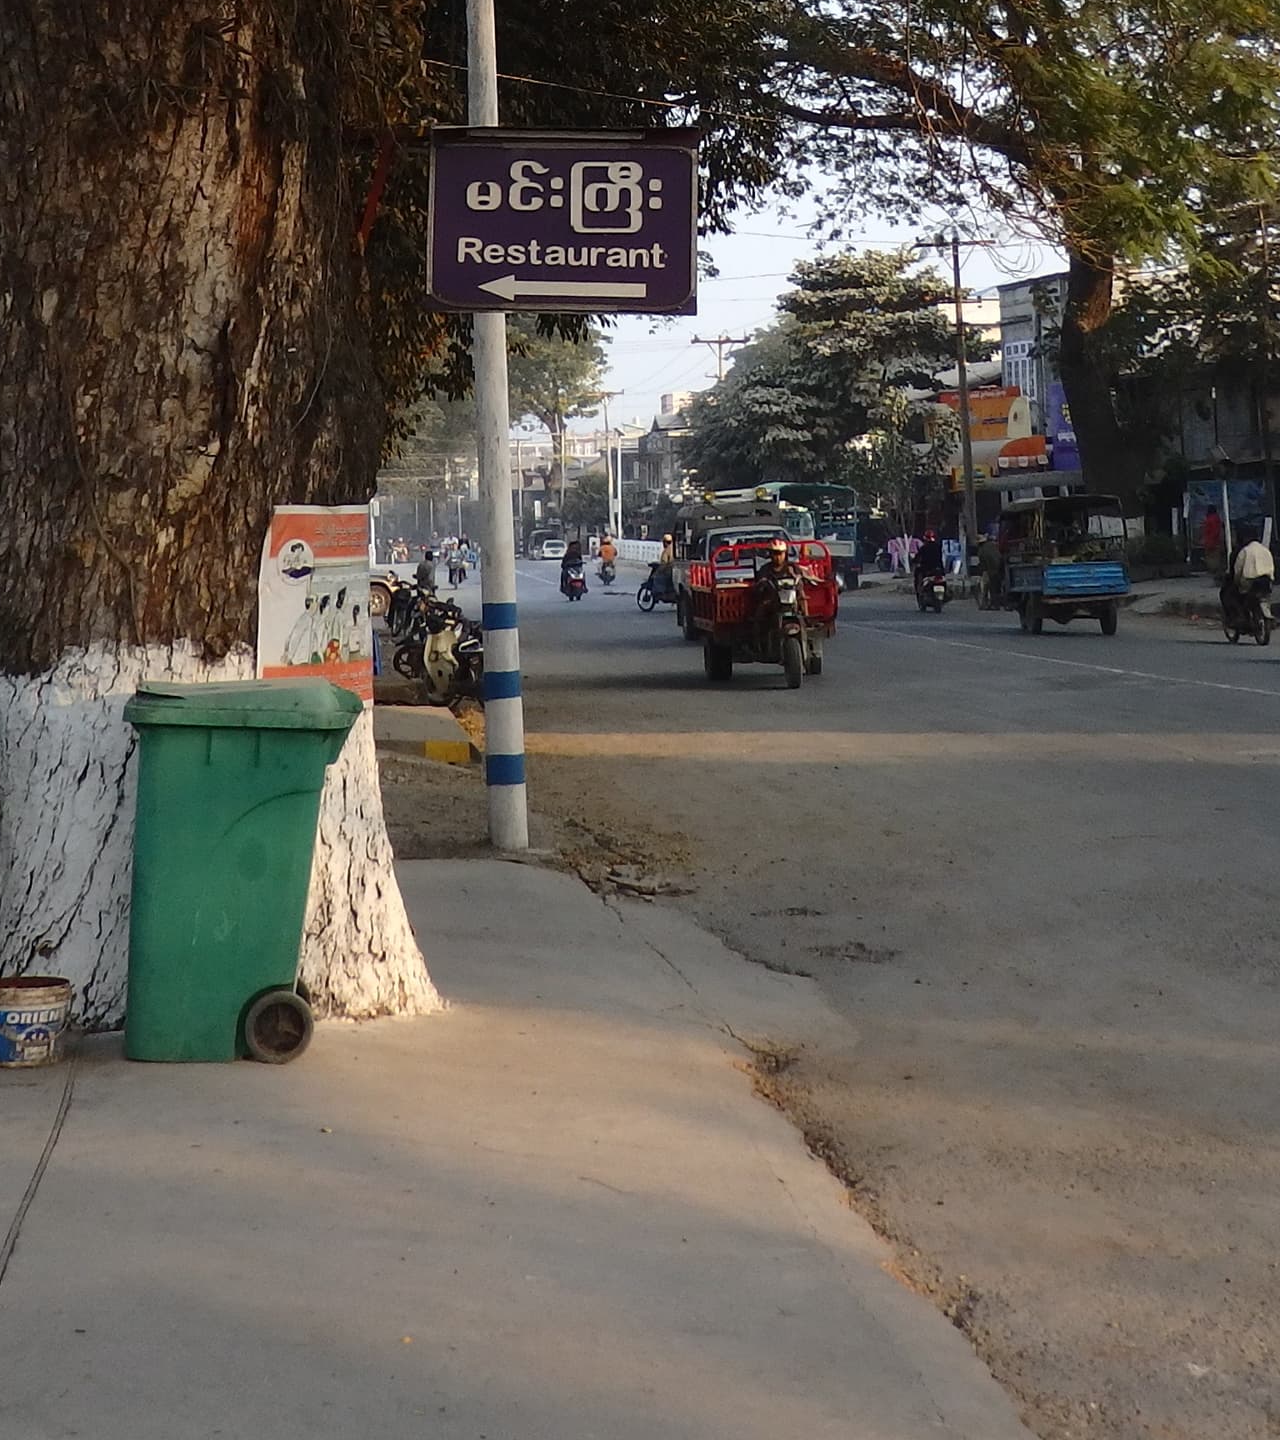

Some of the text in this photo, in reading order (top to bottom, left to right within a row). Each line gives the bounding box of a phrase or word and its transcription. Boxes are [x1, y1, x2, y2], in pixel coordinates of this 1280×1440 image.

[466, 160, 663, 234] မင်းကြီး
[457, 237, 666, 269] Restaurant
